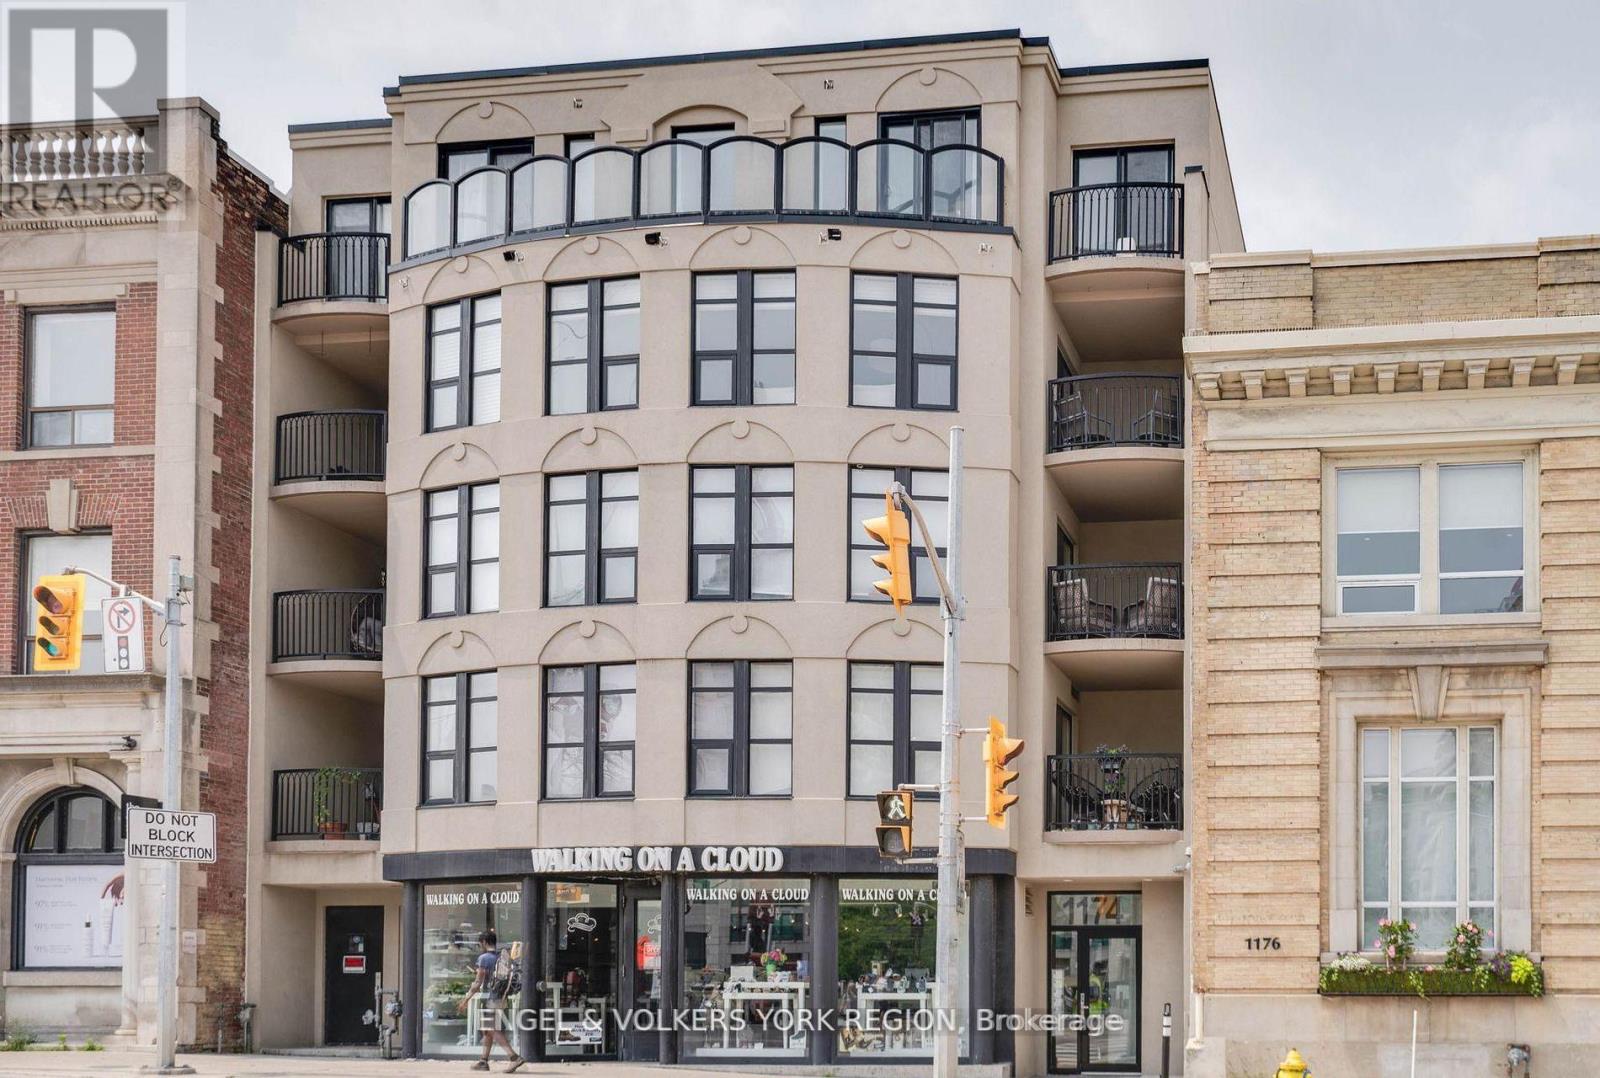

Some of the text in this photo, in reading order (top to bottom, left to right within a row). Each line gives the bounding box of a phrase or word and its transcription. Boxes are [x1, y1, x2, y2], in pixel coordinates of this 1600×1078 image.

[145, 812, 198, 826] DO NOT
[148, 828, 195, 842] BLOCK
[131, 844, 212, 859] INTERSECTION
[531, 847, 784, 873] WALKING ON A CLOUD
[426, 890, 520, 906] WALKING ON A CLOUD
[686, 888, 809, 901] WALKING ON A CLOUD
[842, 888, 892, 901] WALKING
[898, 888, 913, 901] ON
[917, 888, 925, 901] A
[1244, 937, 1281, 950] 1176
